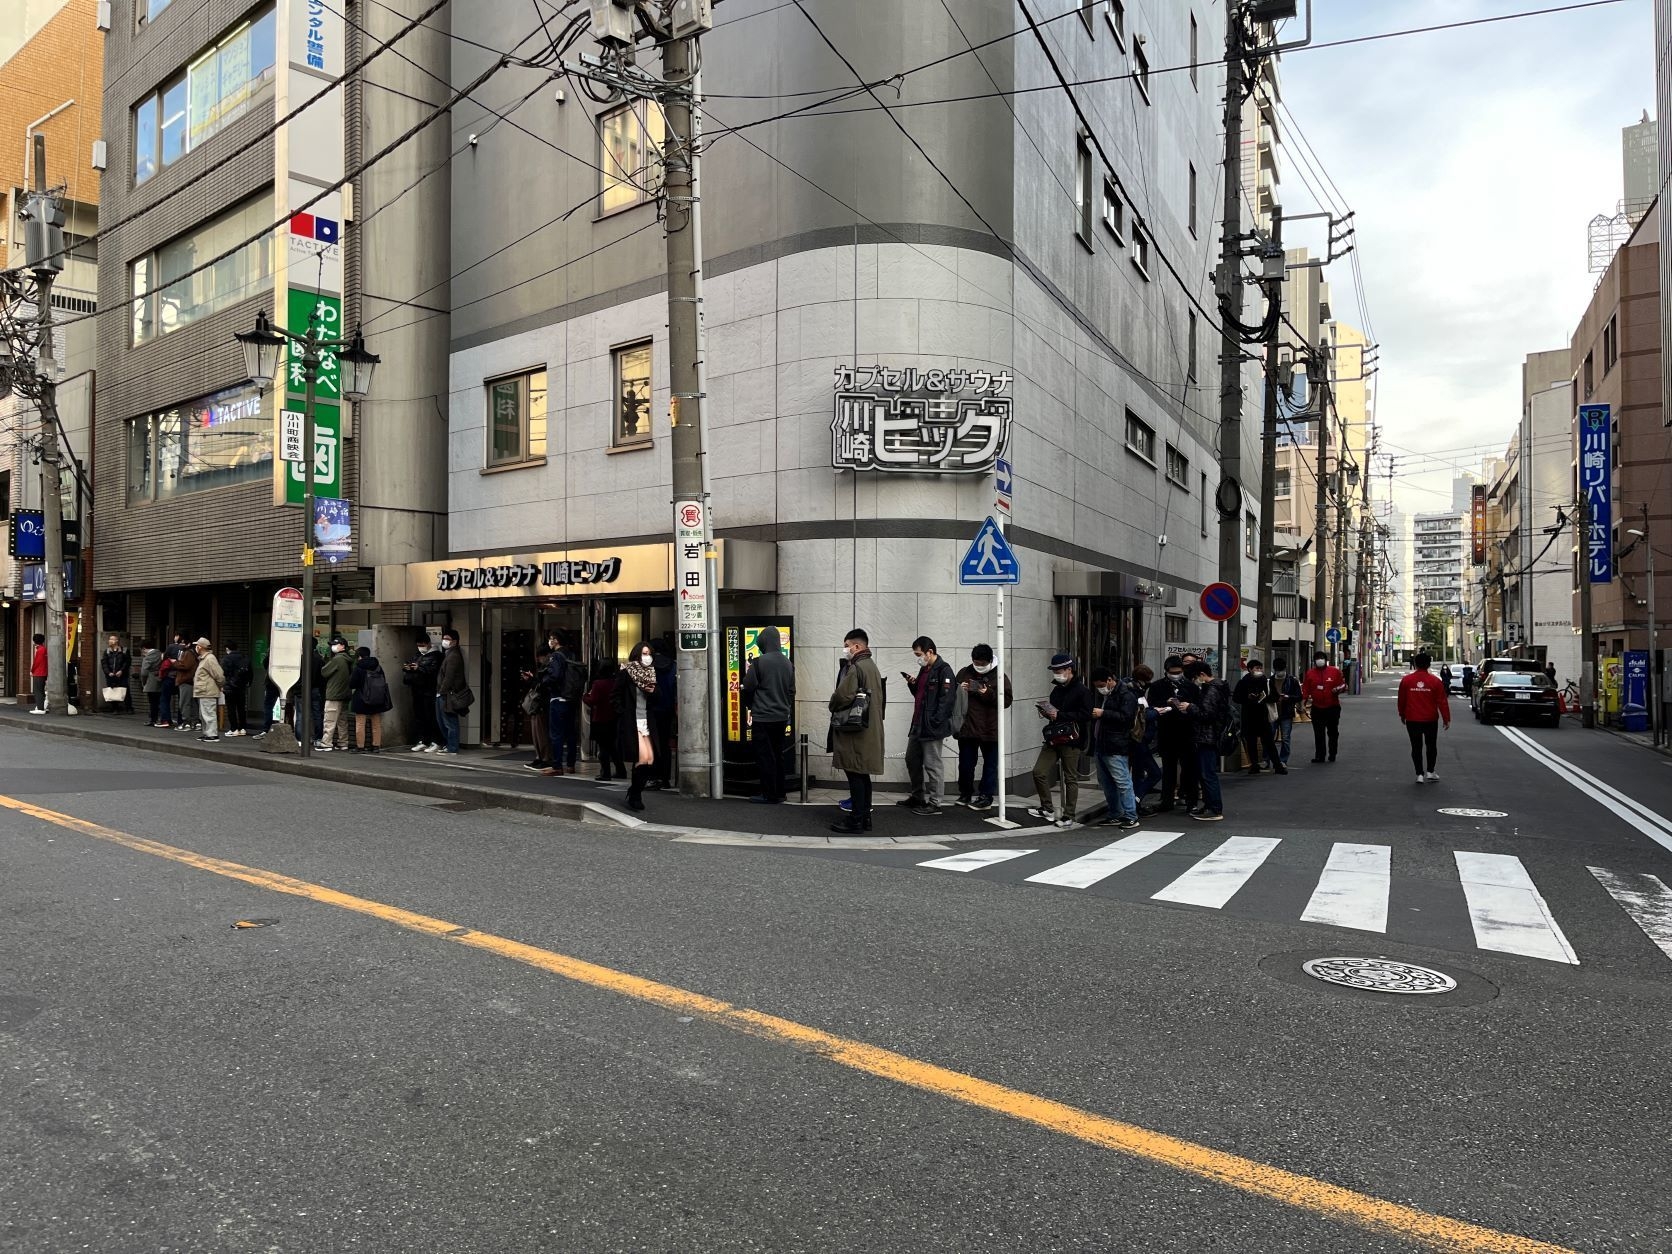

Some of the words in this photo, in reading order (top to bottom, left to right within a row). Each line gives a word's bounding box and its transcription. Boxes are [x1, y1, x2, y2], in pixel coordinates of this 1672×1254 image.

[289, 236, 339, 255] TACTIVE
[834, 365, 1013, 395] カプセル&サウナ
[218, 397, 260, 424] TACTIVE
[841, 401, 870, 463] 川崎
[874, 402, 1010, 464] ビッグ
[685, 509, 698, 523] 質
[1584, 432, 1608, 575] 川崎リバーホテル
[437, 563, 538, 591] カプセル&サウナ
[541, 557, 621, 587] 川崎ビッグ
[684, 543, 700, 587] 岩田
